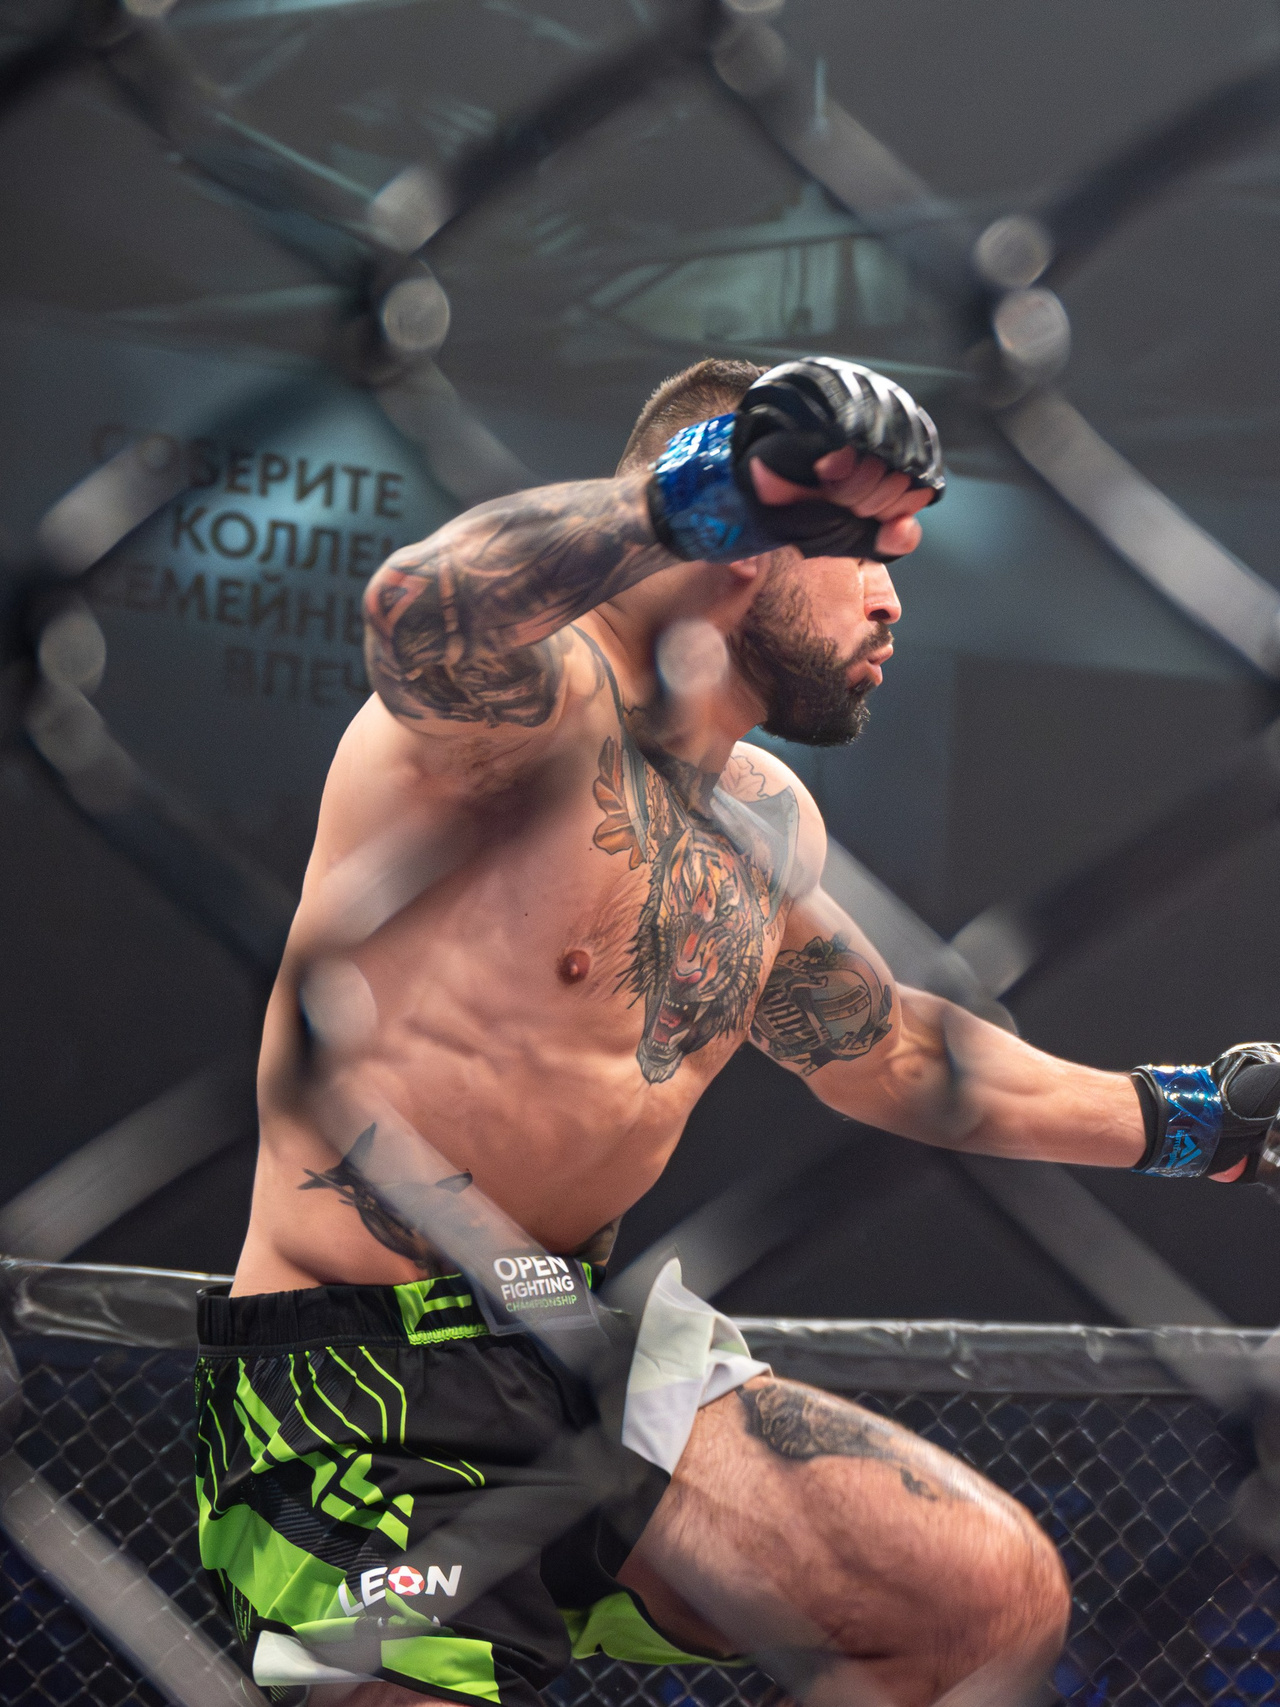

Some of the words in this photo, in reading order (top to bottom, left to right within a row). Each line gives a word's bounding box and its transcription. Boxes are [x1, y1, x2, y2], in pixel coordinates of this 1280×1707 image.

[493, 1255, 570, 1281] OPEN
[500, 1274, 575, 1300] FIGHTING
[505, 1294, 577, 1313] CHAMPIONSHIP
